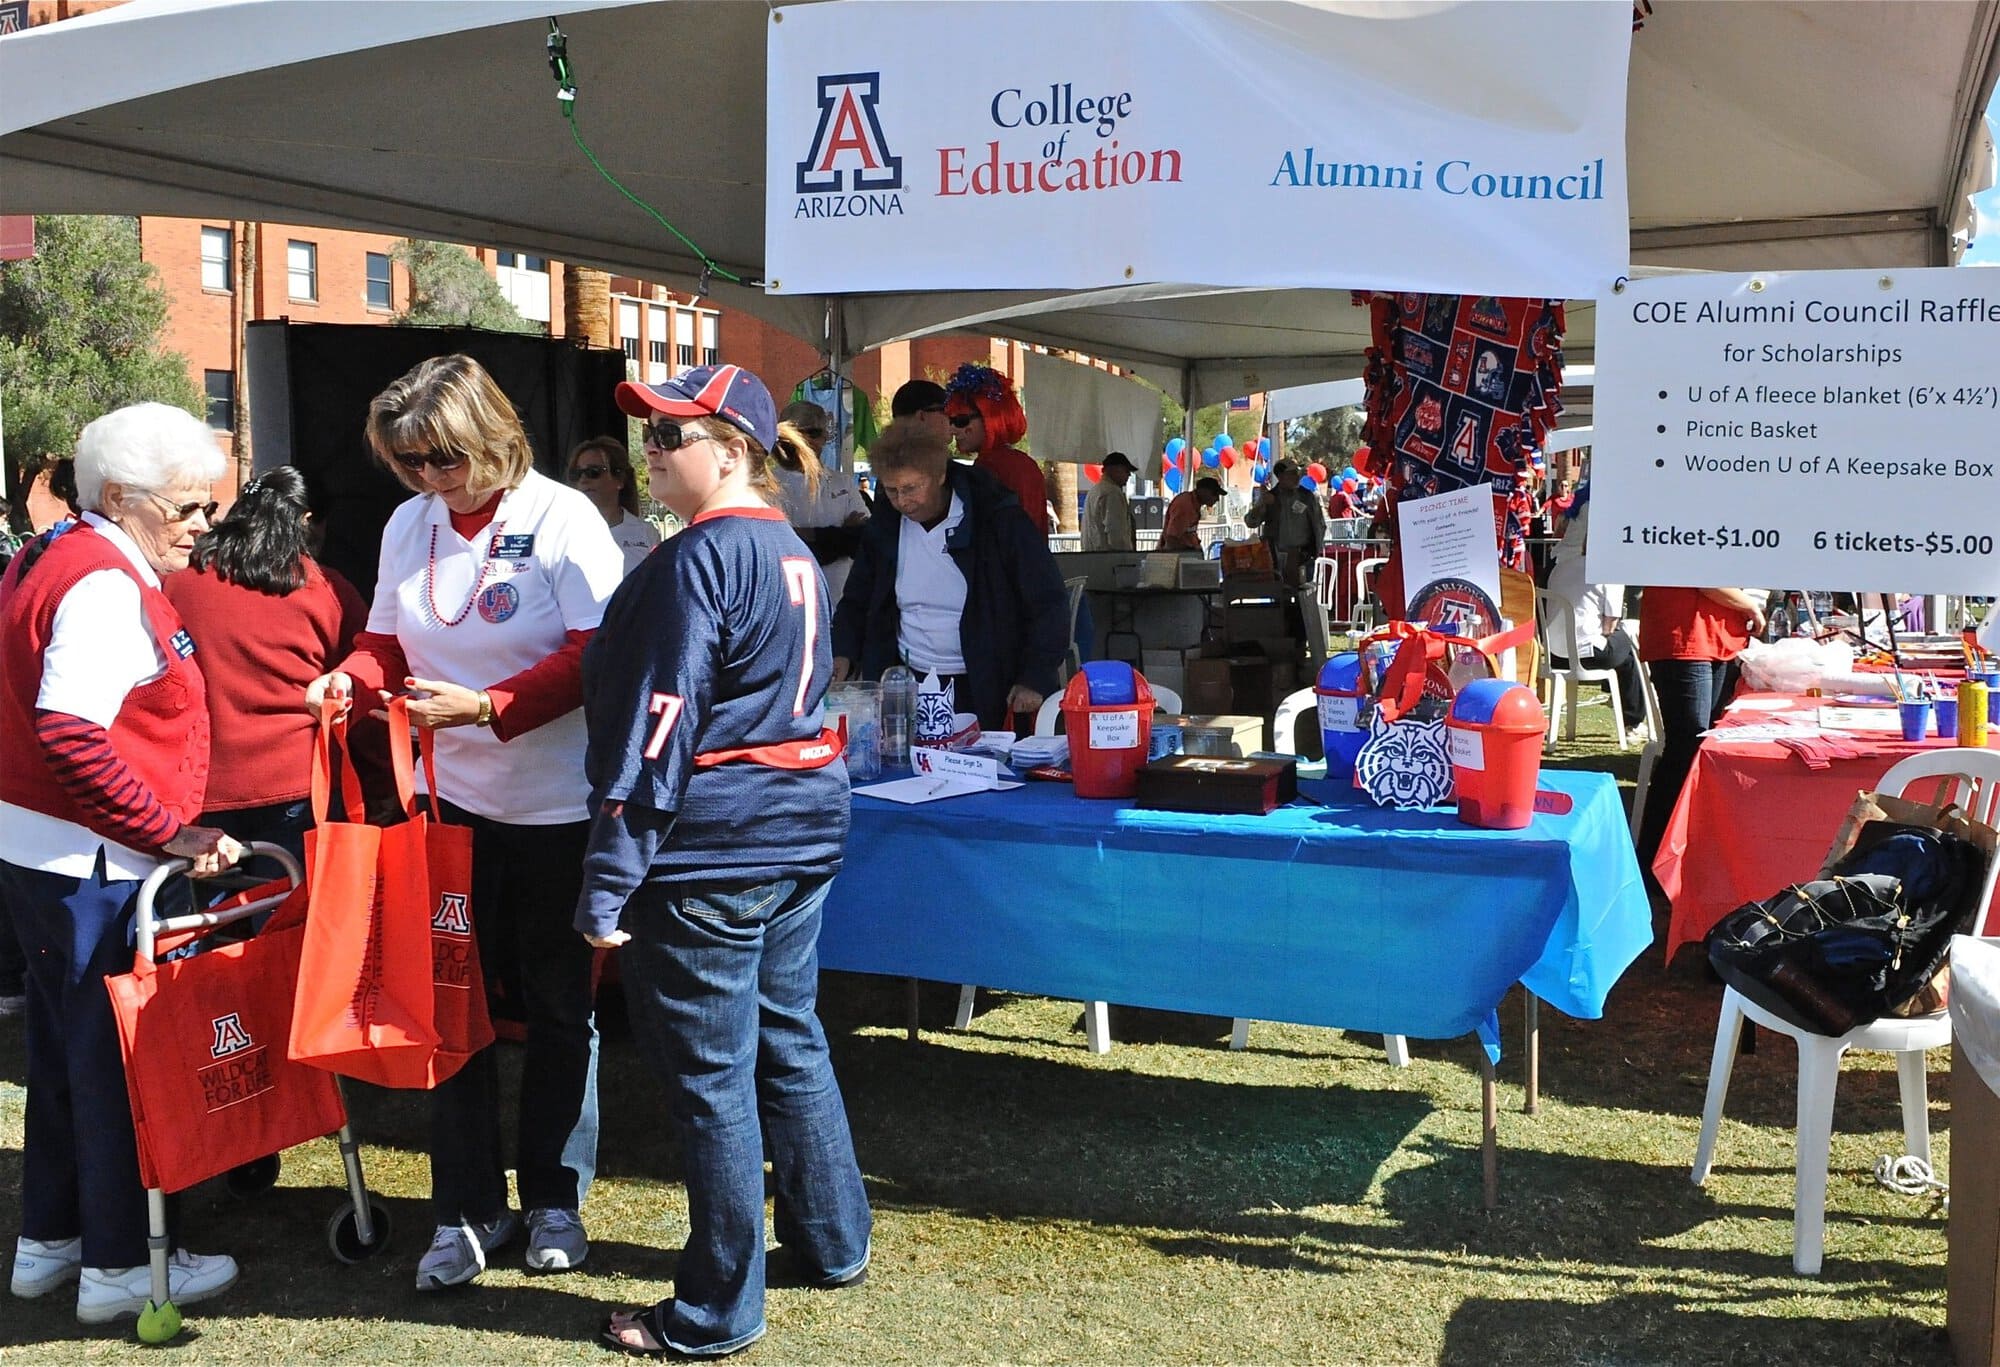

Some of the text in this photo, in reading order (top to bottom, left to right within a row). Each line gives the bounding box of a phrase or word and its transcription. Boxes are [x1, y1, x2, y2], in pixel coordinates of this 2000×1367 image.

[990, 82, 1133, 138] College
[796, 71, 902, 194] A
[1042, 130, 1070, 167] of
[934, 140, 1184, 197] Education
[1268, 147, 1605, 200] Alumni Council
[795, 192, 904, 219] ARIZONA
[1633, 298, 2000, 324] COE Alumni Council Raffle
[1723, 343, 1902, 366] for Scholarships
[1688, 386, 1702, 403] U
[1709, 385, 1729, 403] of
[1735, 386, 1749, 403] A
[1755, 385, 1817, 404] fleece
[1823, 386, 1901, 404] blanket
[1686, 420, 1818, 439] Picnic Basket
[1685, 455, 1994, 480] Wooden U of A Keepsake Box
[1420, 496, 1469, 513] PICNIC TIME
[1622, 525, 1781, 549] 1 ticket-$1.00
[1813, 531, 1993, 556] 6 tickets-$5.00
[781, 556, 818, 718] 7
[644, 689, 685, 761] 7
[1096, 724, 1130, 732] Keepsake
[431, 892, 471, 936] A
[210, 1012, 253, 1060] A
[205, 1080, 242, 1107] FOR
